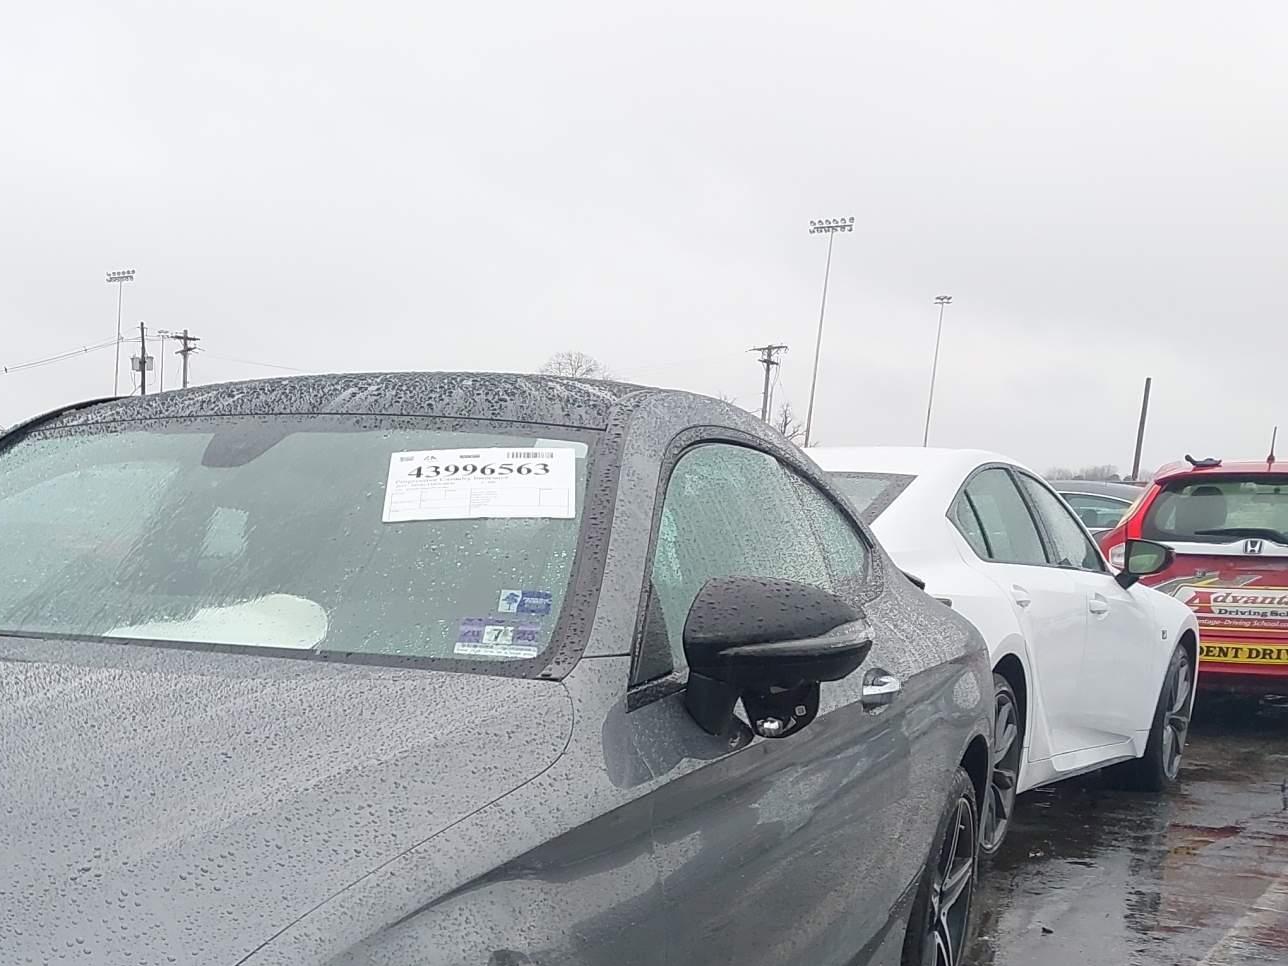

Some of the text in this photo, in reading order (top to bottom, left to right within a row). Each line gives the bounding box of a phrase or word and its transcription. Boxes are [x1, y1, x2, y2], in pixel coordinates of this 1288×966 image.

[407, 462, 550, 478] 43996563
[1217, 608, 1269, 618] Driving
[492, 628, 503, 641] 7
